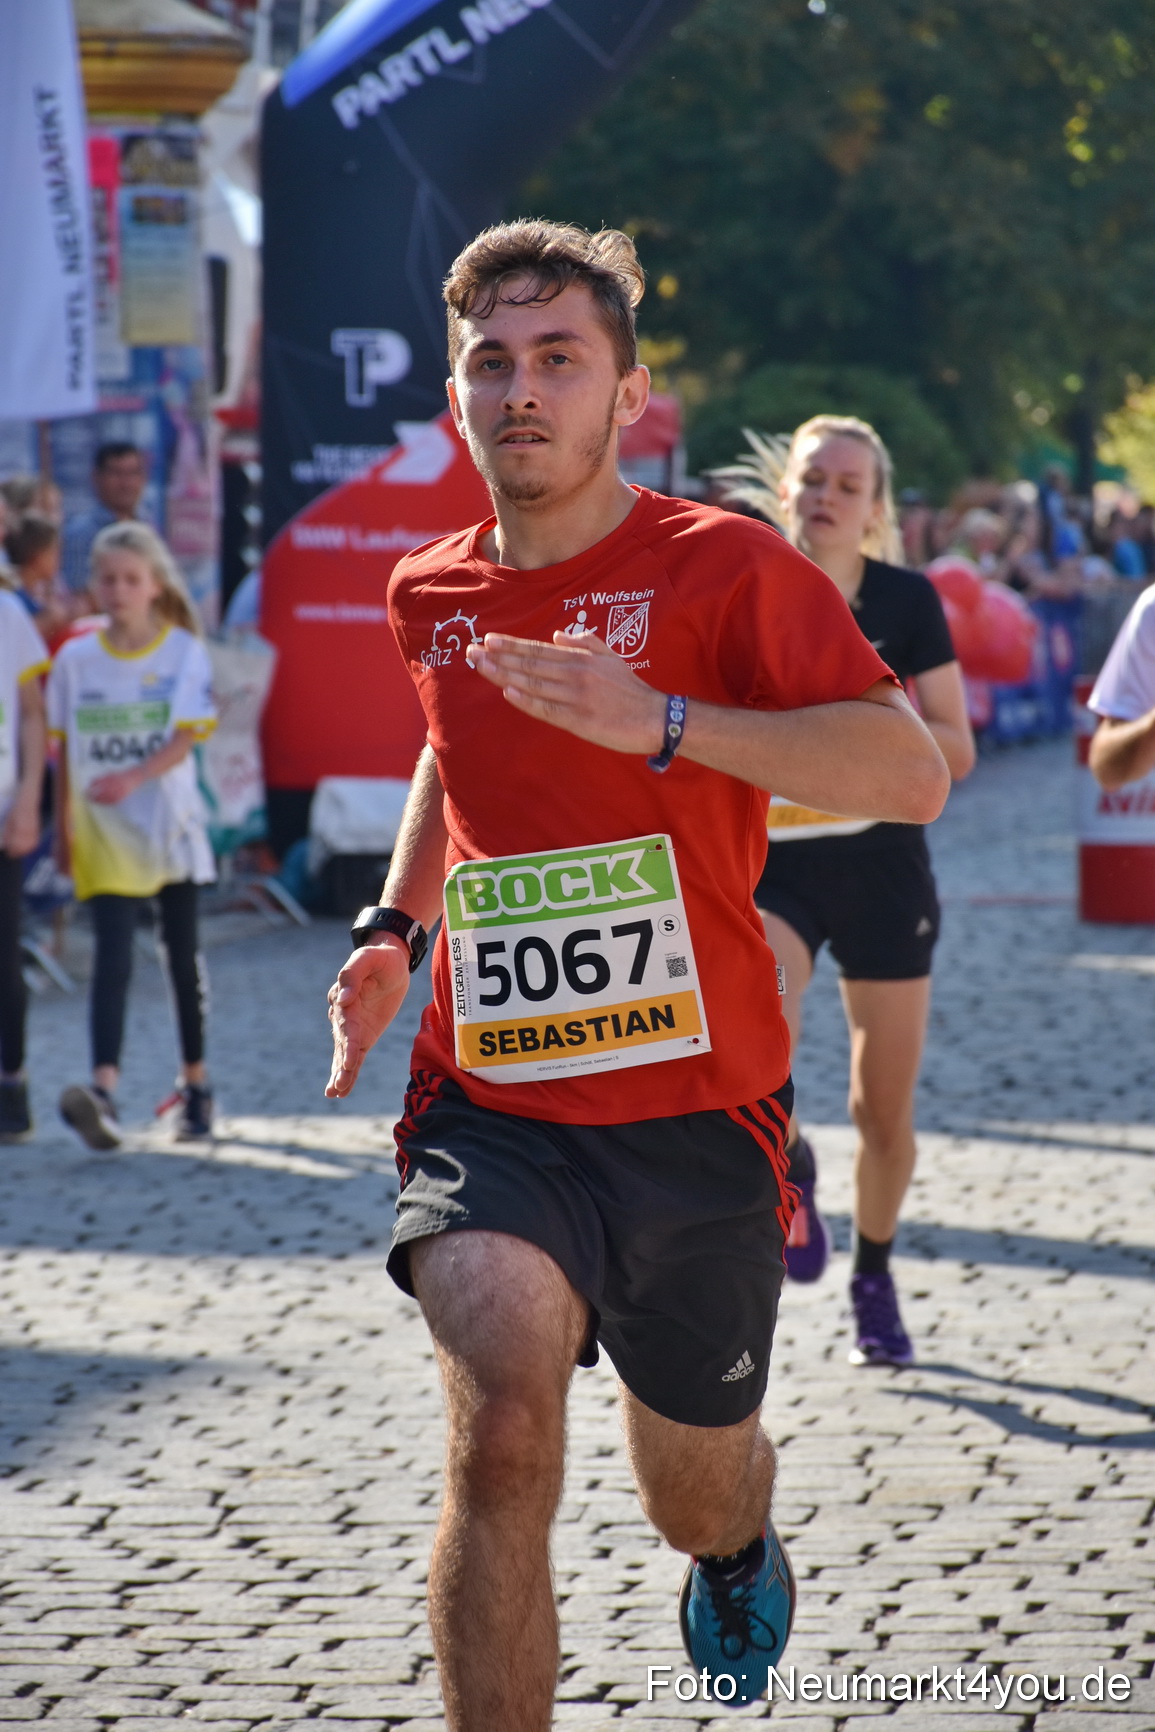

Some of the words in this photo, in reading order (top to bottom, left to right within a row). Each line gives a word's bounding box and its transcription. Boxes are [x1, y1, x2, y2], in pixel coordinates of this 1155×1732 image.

[332, 26, 472, 129] PARTL
[34, 86, 84, 275] NEUMARKT
[563, 593, 587, 611] TSV
[591, 588, 654, 605] Wolfstein
[618, 613, 644, 654] TSV
[420, 648, 452, 676] Spitz
[456, 848, 659, 921] BOCK
[663, 919, 675, 931] S
[476, 918, 654, 1007] 5067
[479, 1004, 676, 1057] SEBASTIAN
[721, 1363, 755, 1382] adidas
